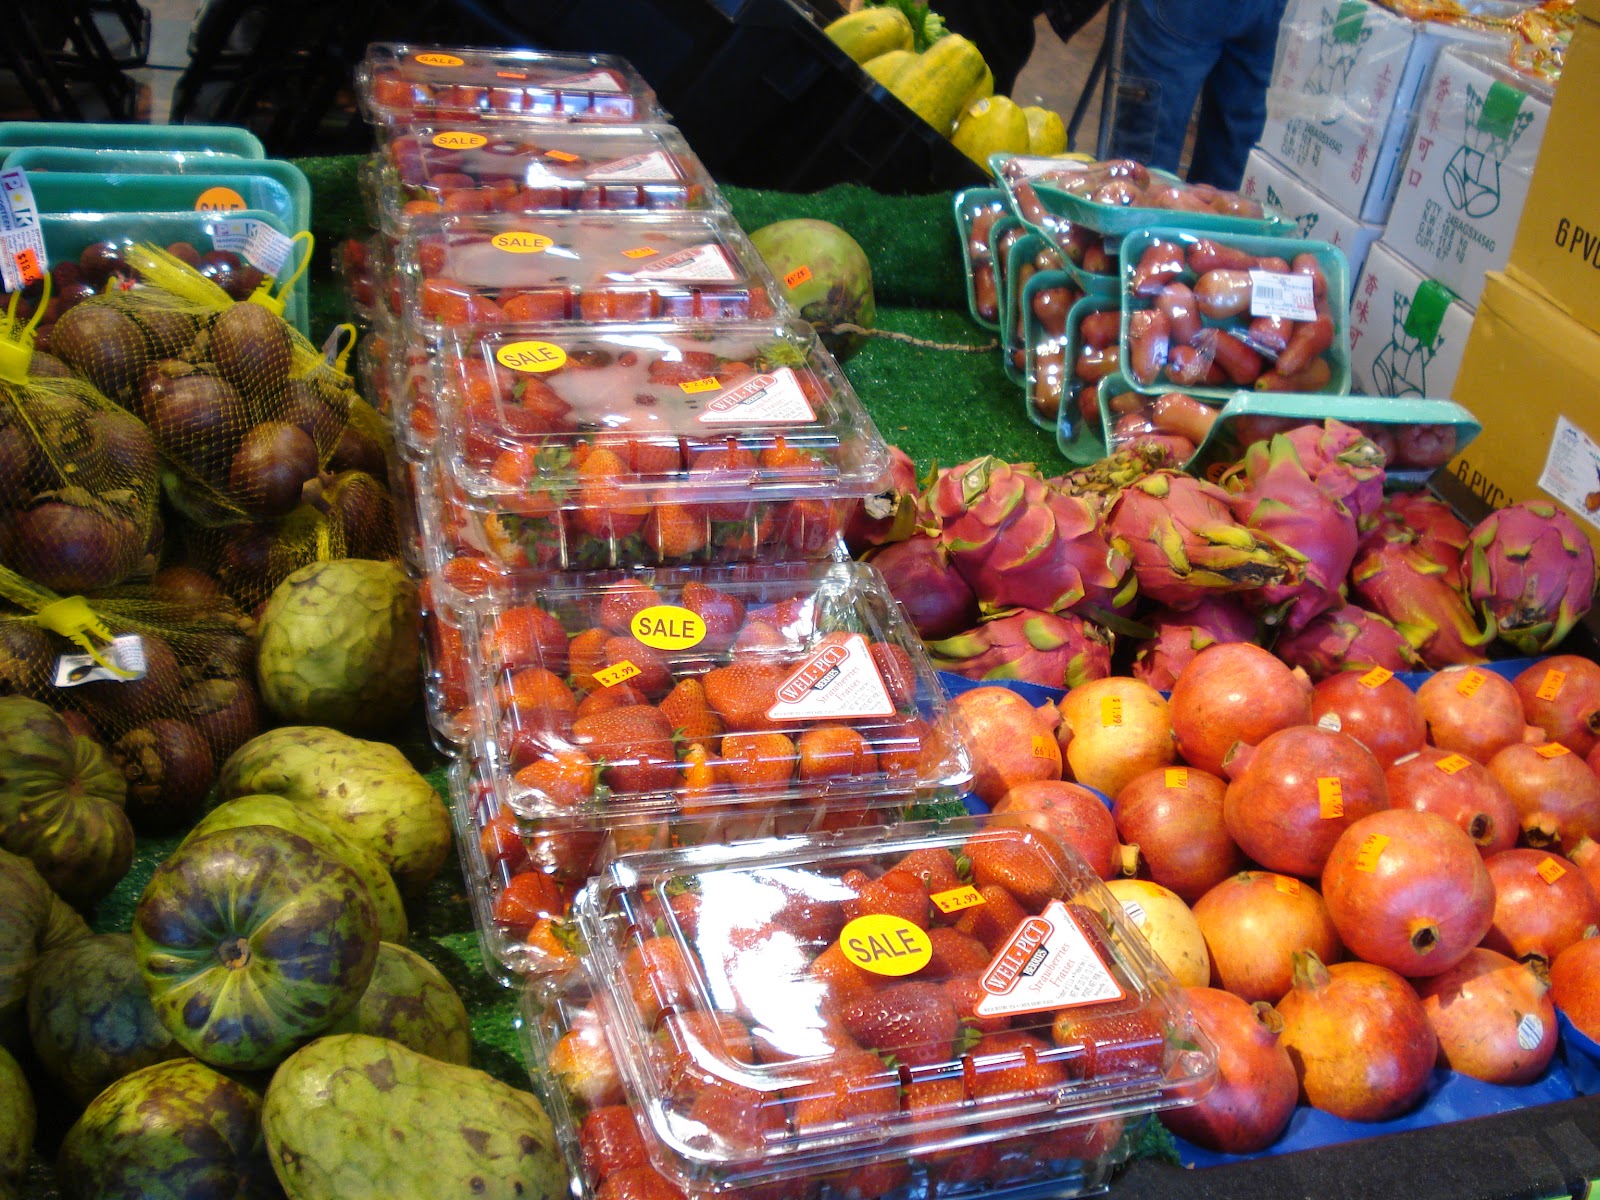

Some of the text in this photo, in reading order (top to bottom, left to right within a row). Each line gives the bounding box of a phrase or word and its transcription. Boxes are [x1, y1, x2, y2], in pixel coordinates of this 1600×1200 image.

[420, 55, 456, 65] SALE
[438, 137, 479, 145] SALE
[498, 237, 544, 248] SALE
[1554, 217, 1570, 248] 6
[504, 347, 558, 367] SALE
[713, 392, 742, 411] WELL
[744, 379, 768, 395] PICT
[638, 617, 695, 639] SALE
[782, 672, 818, 700] WELL
[815, 648, 843, 673] PICT
[817, 666, 859, 704] Strawberries
[848, 928, 923, 963] SALE
[986, 954, 1024, 991] WELL
[1016, 922, 1045, 954] PICT
[1024, 948, 1048, 976] BERRIES
[1028, 942, 1071, 993] Strawberries
[1049, 959, 1076, 988] Fraises
